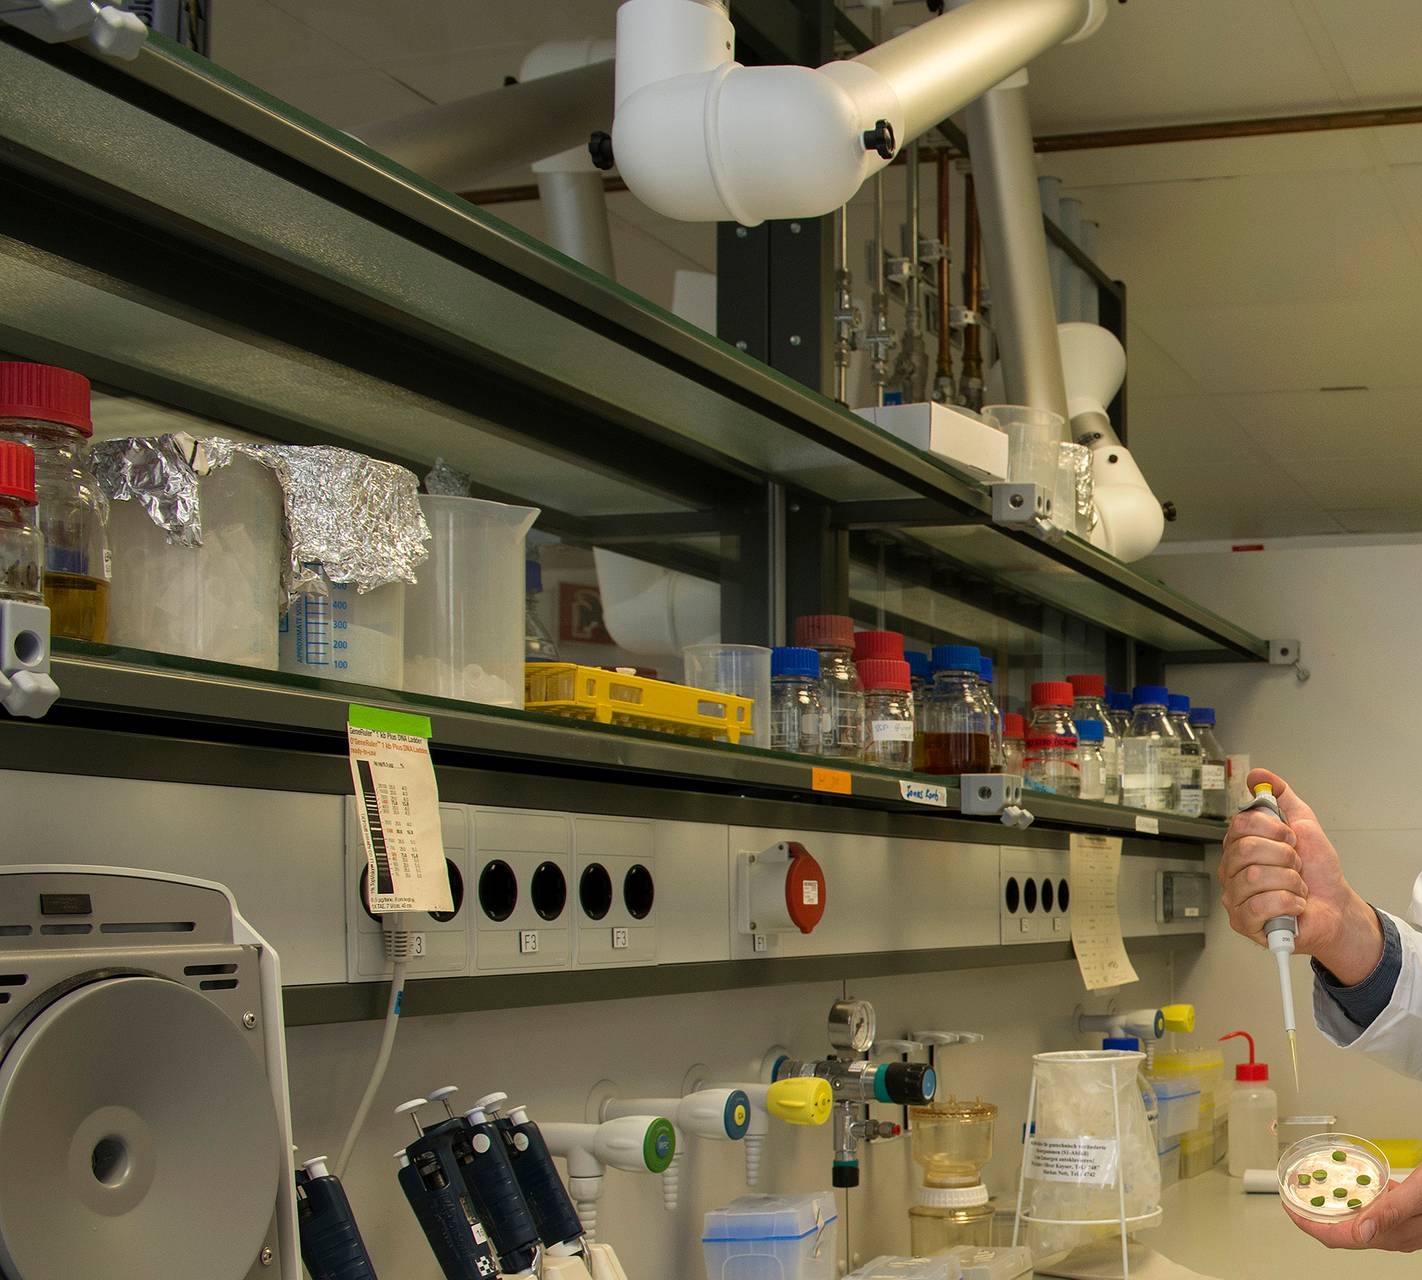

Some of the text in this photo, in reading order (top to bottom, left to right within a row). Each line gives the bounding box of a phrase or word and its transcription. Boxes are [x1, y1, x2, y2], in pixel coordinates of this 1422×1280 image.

[332, 601, 348, 610] 400
[333, 620, 348, 629] 300
[333, 640, 348, 649] 200
[334, 660, 348, 669] 100
[525, 934, 537, 950] F3
[616, 931, 627, 946] F3
